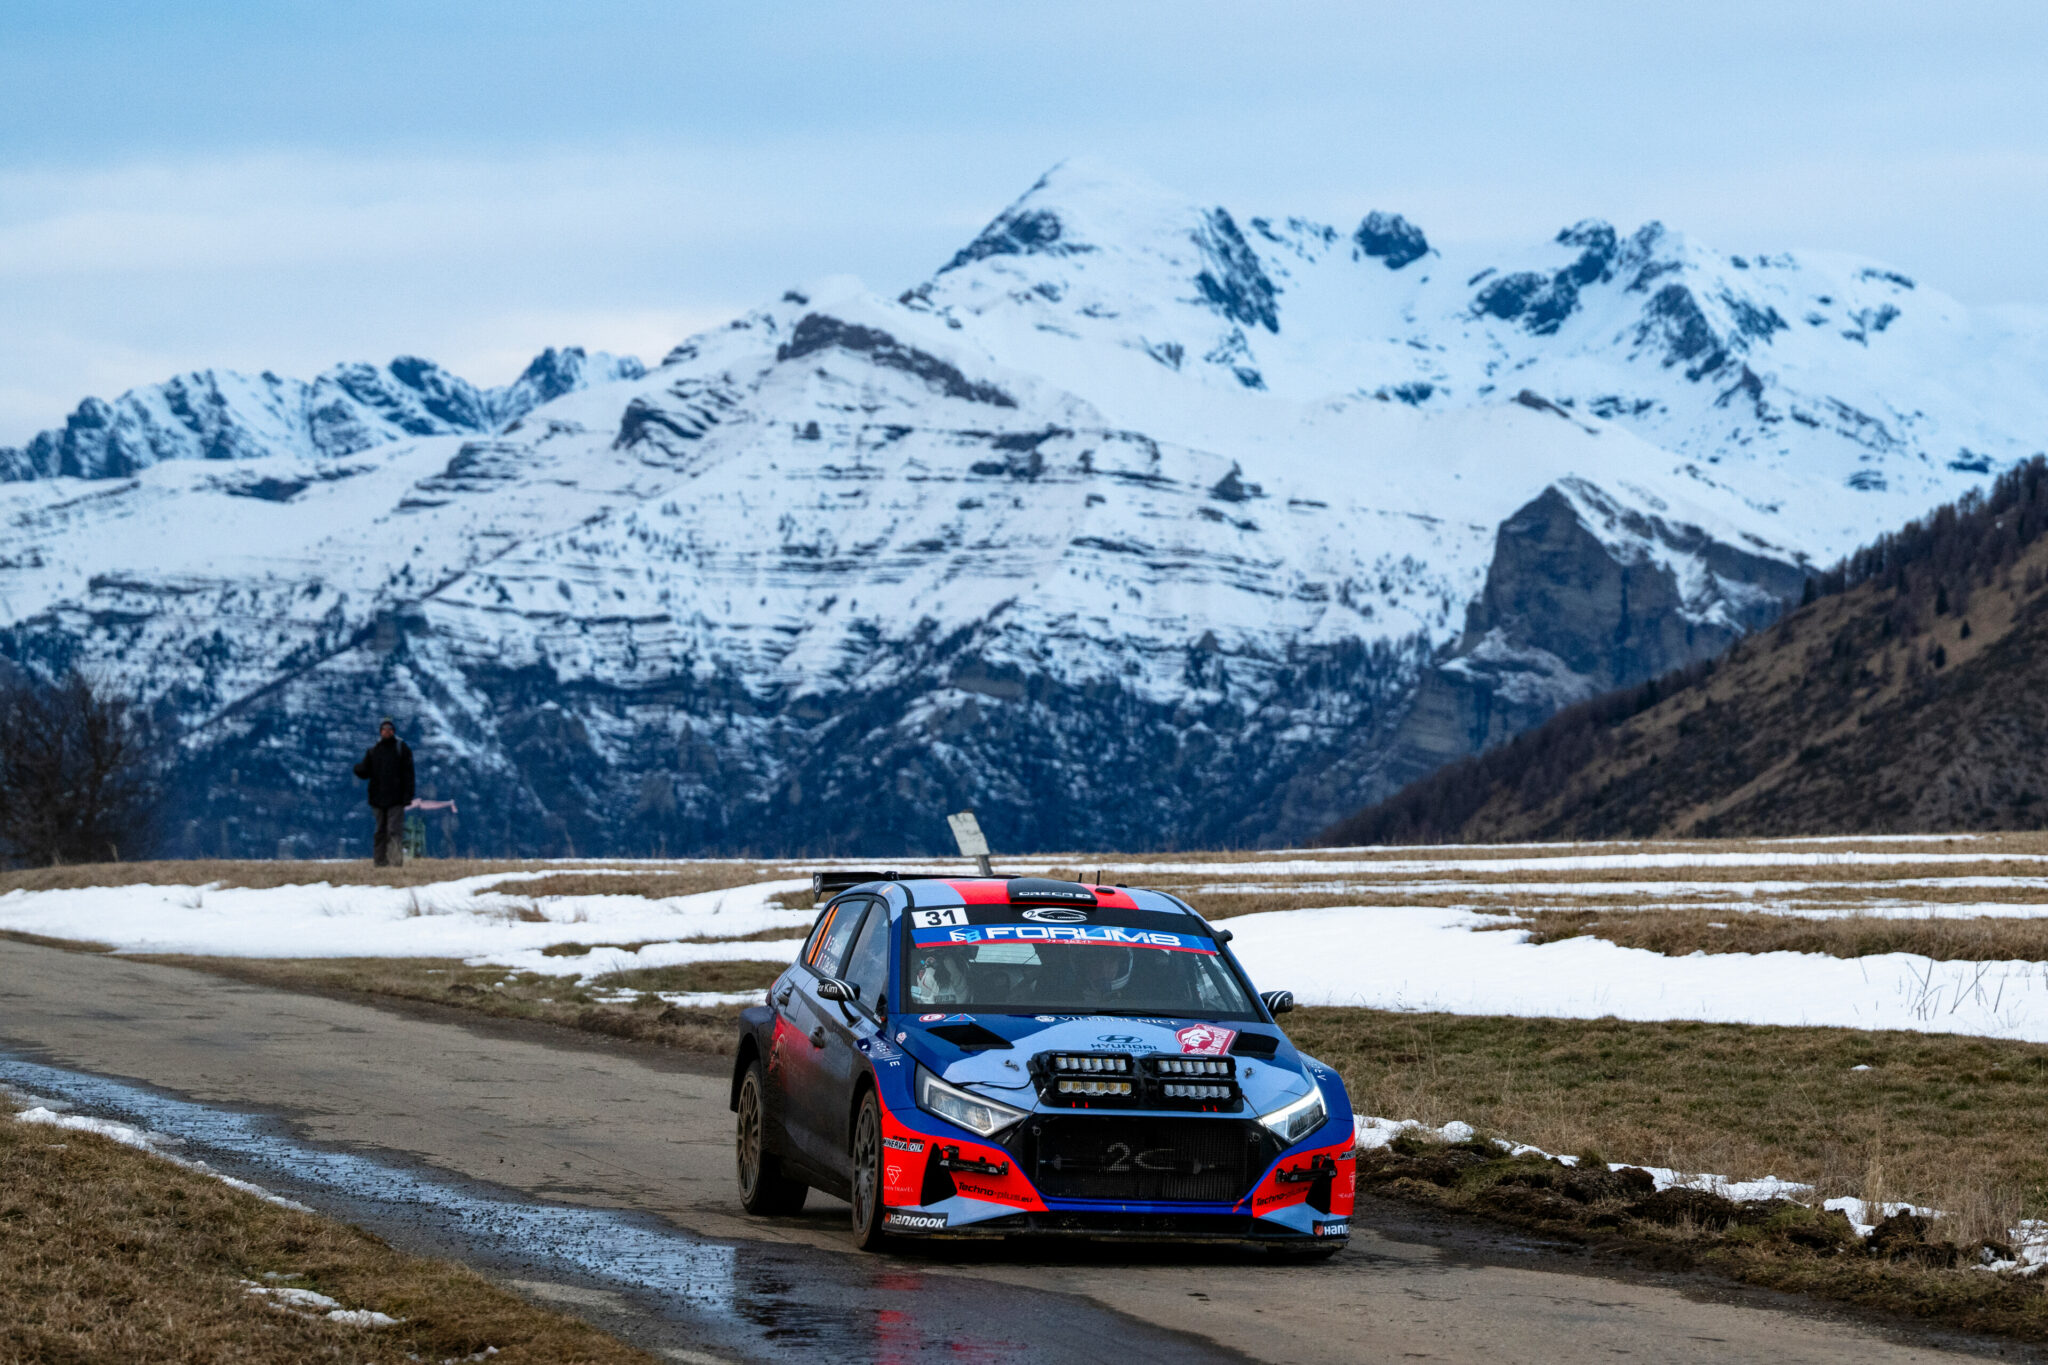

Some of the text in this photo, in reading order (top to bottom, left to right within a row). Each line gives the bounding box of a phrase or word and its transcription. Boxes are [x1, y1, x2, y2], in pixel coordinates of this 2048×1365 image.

[925, 910, 957, 926] 31
[986, 926, 1181, 947] FORUM8
[824, 983, 838, 994] Kim
